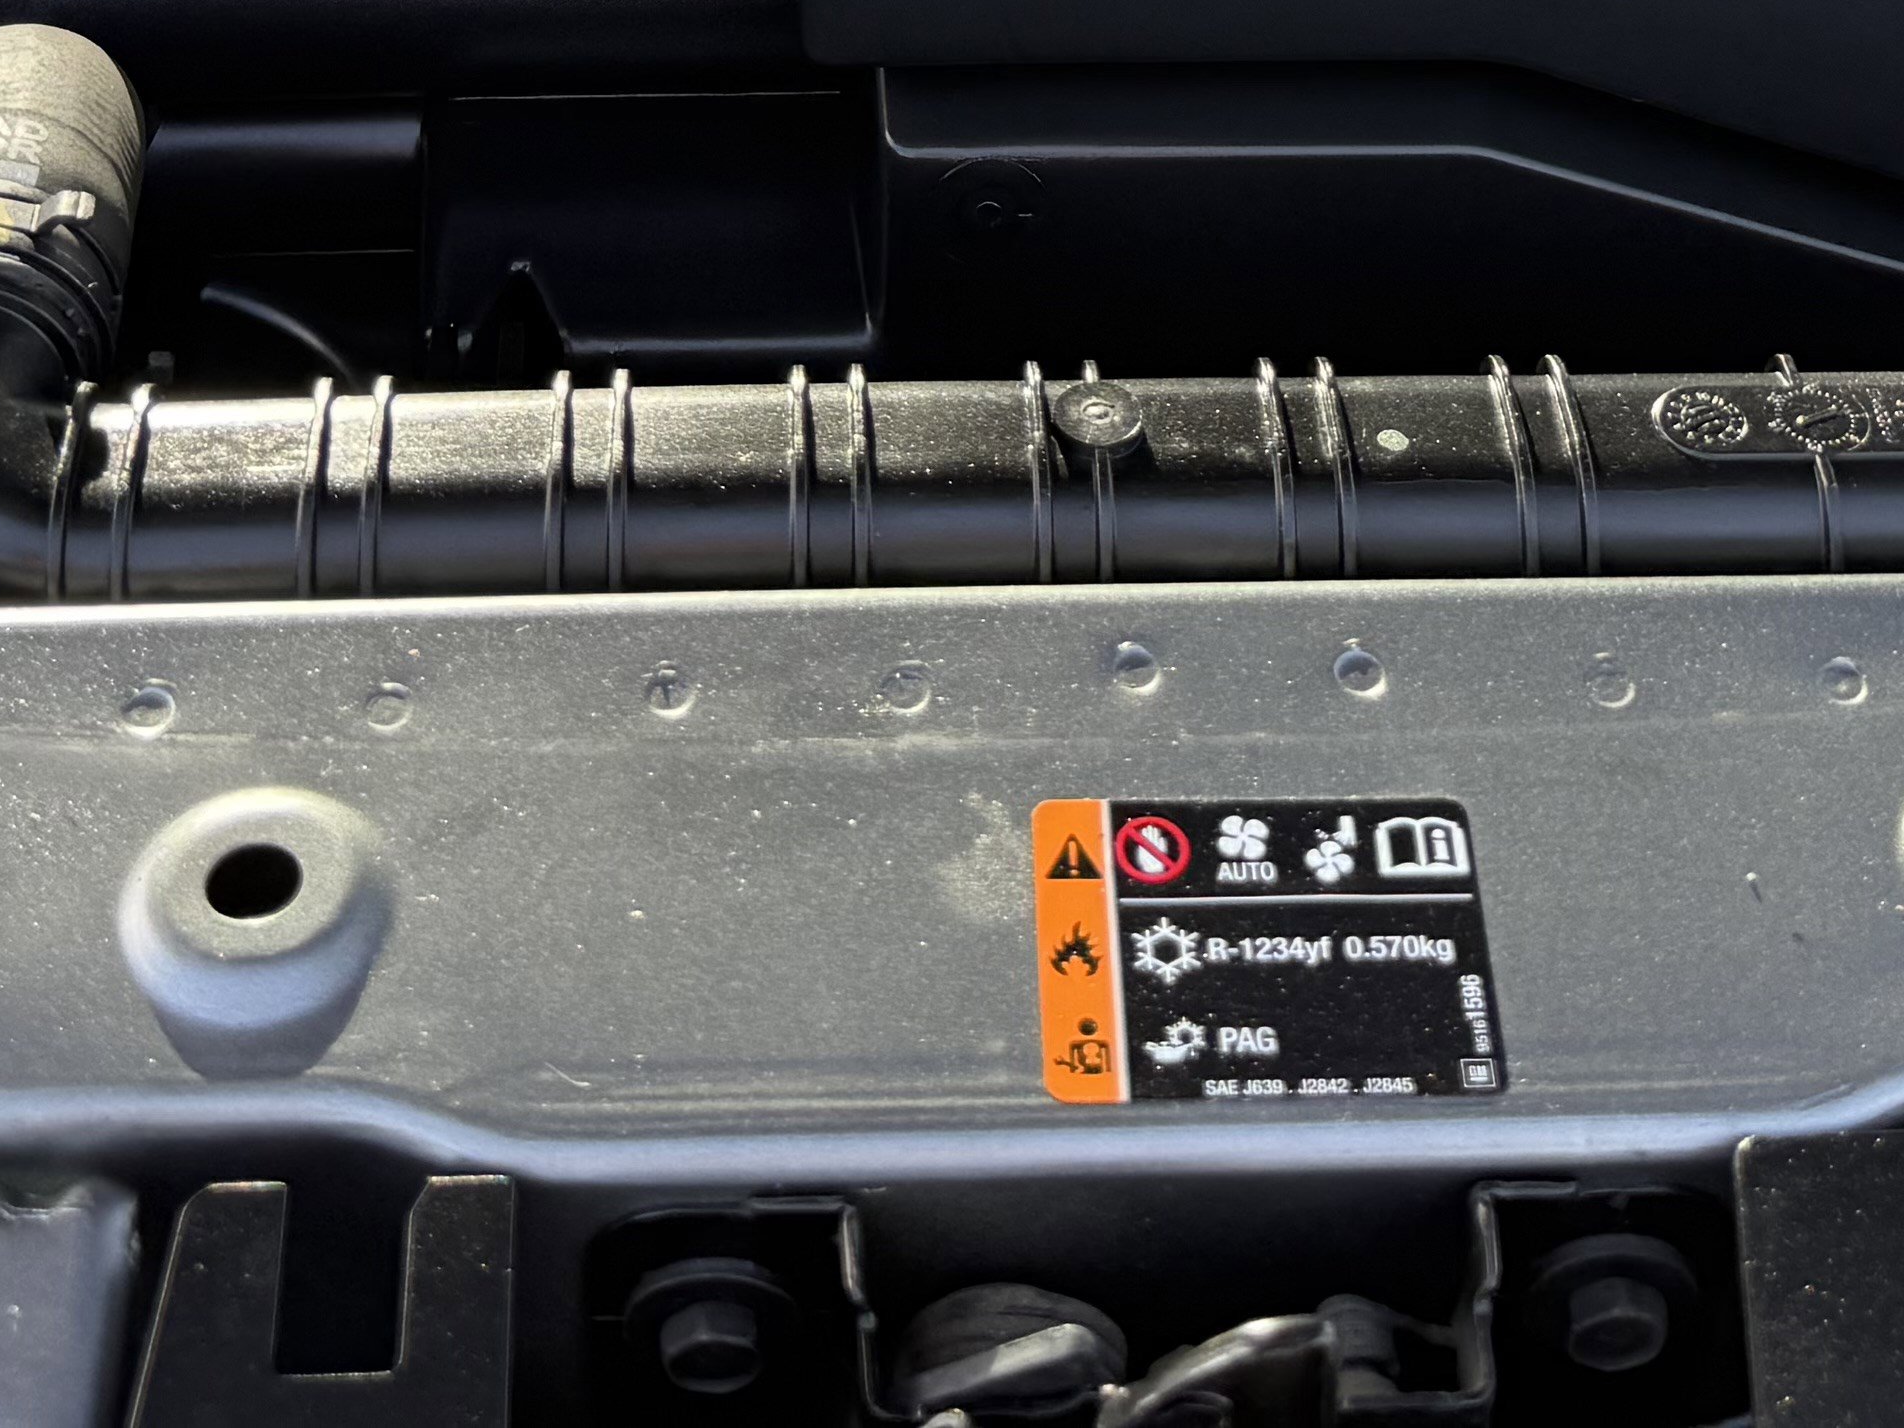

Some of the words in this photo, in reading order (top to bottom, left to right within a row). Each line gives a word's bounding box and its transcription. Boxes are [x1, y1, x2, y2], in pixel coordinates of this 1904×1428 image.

[1217, 861, 1277, 882] AUTO
[1208, 935, 1332, 965] R-1234yf
[1343, 934, 1454, 965] 0.570kg
[1458, 974, 1491, 1054] 95161596
[1219, 1026, 1278, 1054] PAG
[1205, 1080, 1238, 1095] SAE
[1243, 1079, 1284, 1095] J639
[1298, 1078, 1349, 1094] J2842
[1363, 1077, 1414, 1094] J2845
